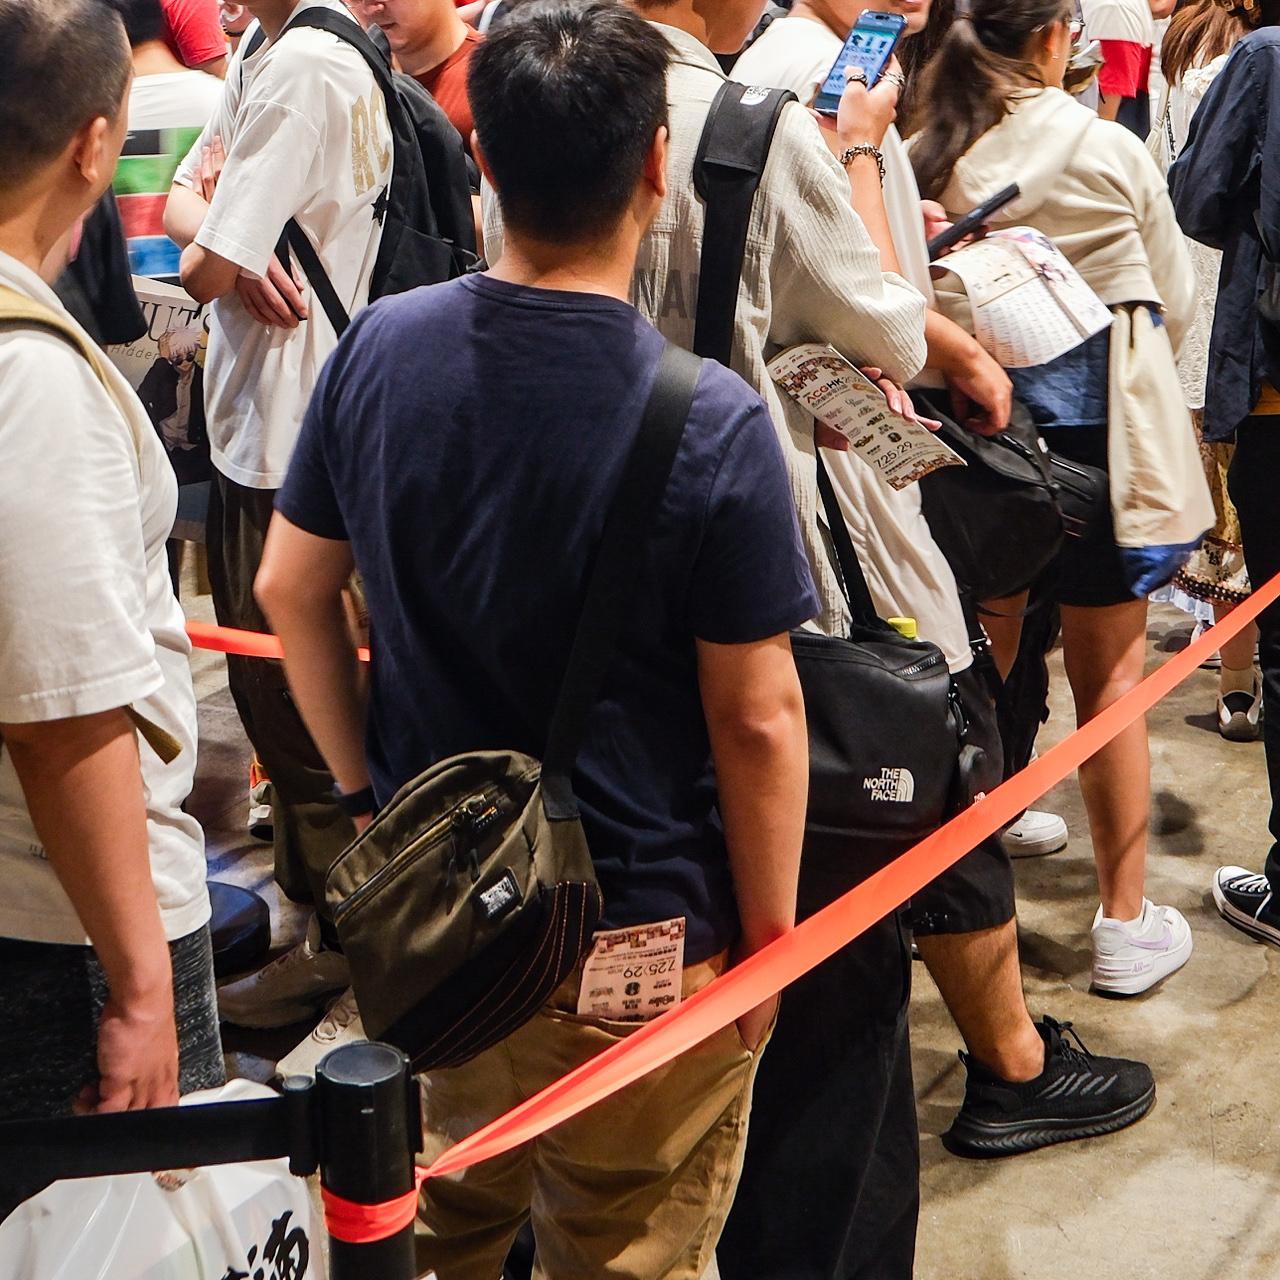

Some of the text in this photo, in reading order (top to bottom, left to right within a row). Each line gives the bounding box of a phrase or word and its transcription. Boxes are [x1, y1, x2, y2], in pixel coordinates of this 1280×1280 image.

[806, 377, 844, 404] ACGHK
[881, 768, 900, 780] THE
[863, 778, 899, 790] NORTH
[871, 789, 897, 801] FACE
